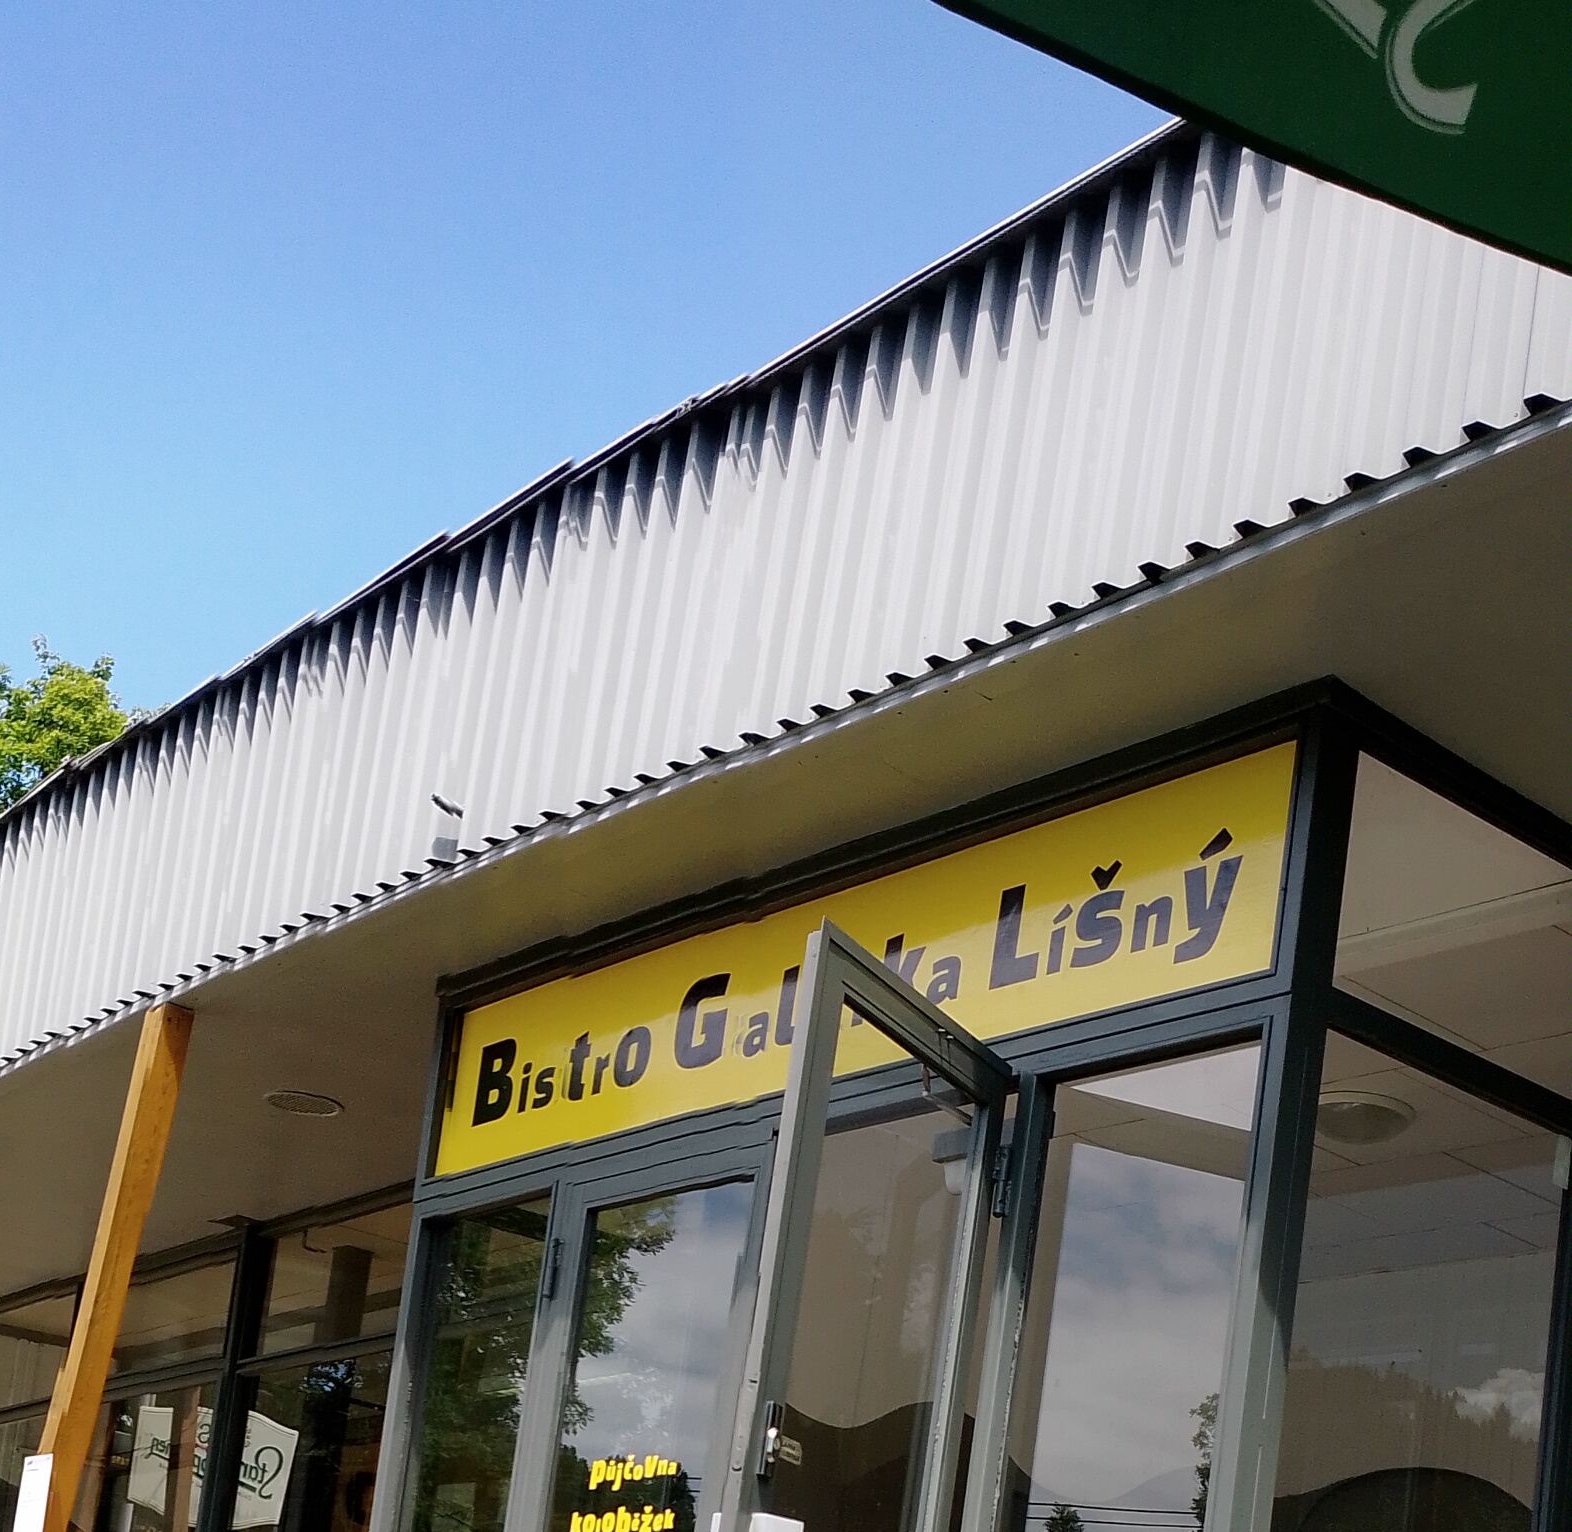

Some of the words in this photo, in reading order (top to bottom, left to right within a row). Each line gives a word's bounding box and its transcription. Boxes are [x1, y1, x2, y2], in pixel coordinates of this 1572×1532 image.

[472, 1026, 651, 1128] Bistro
[675, 933, 961, 1069] Galka
[989, 827, 1243, 991] Líšný
